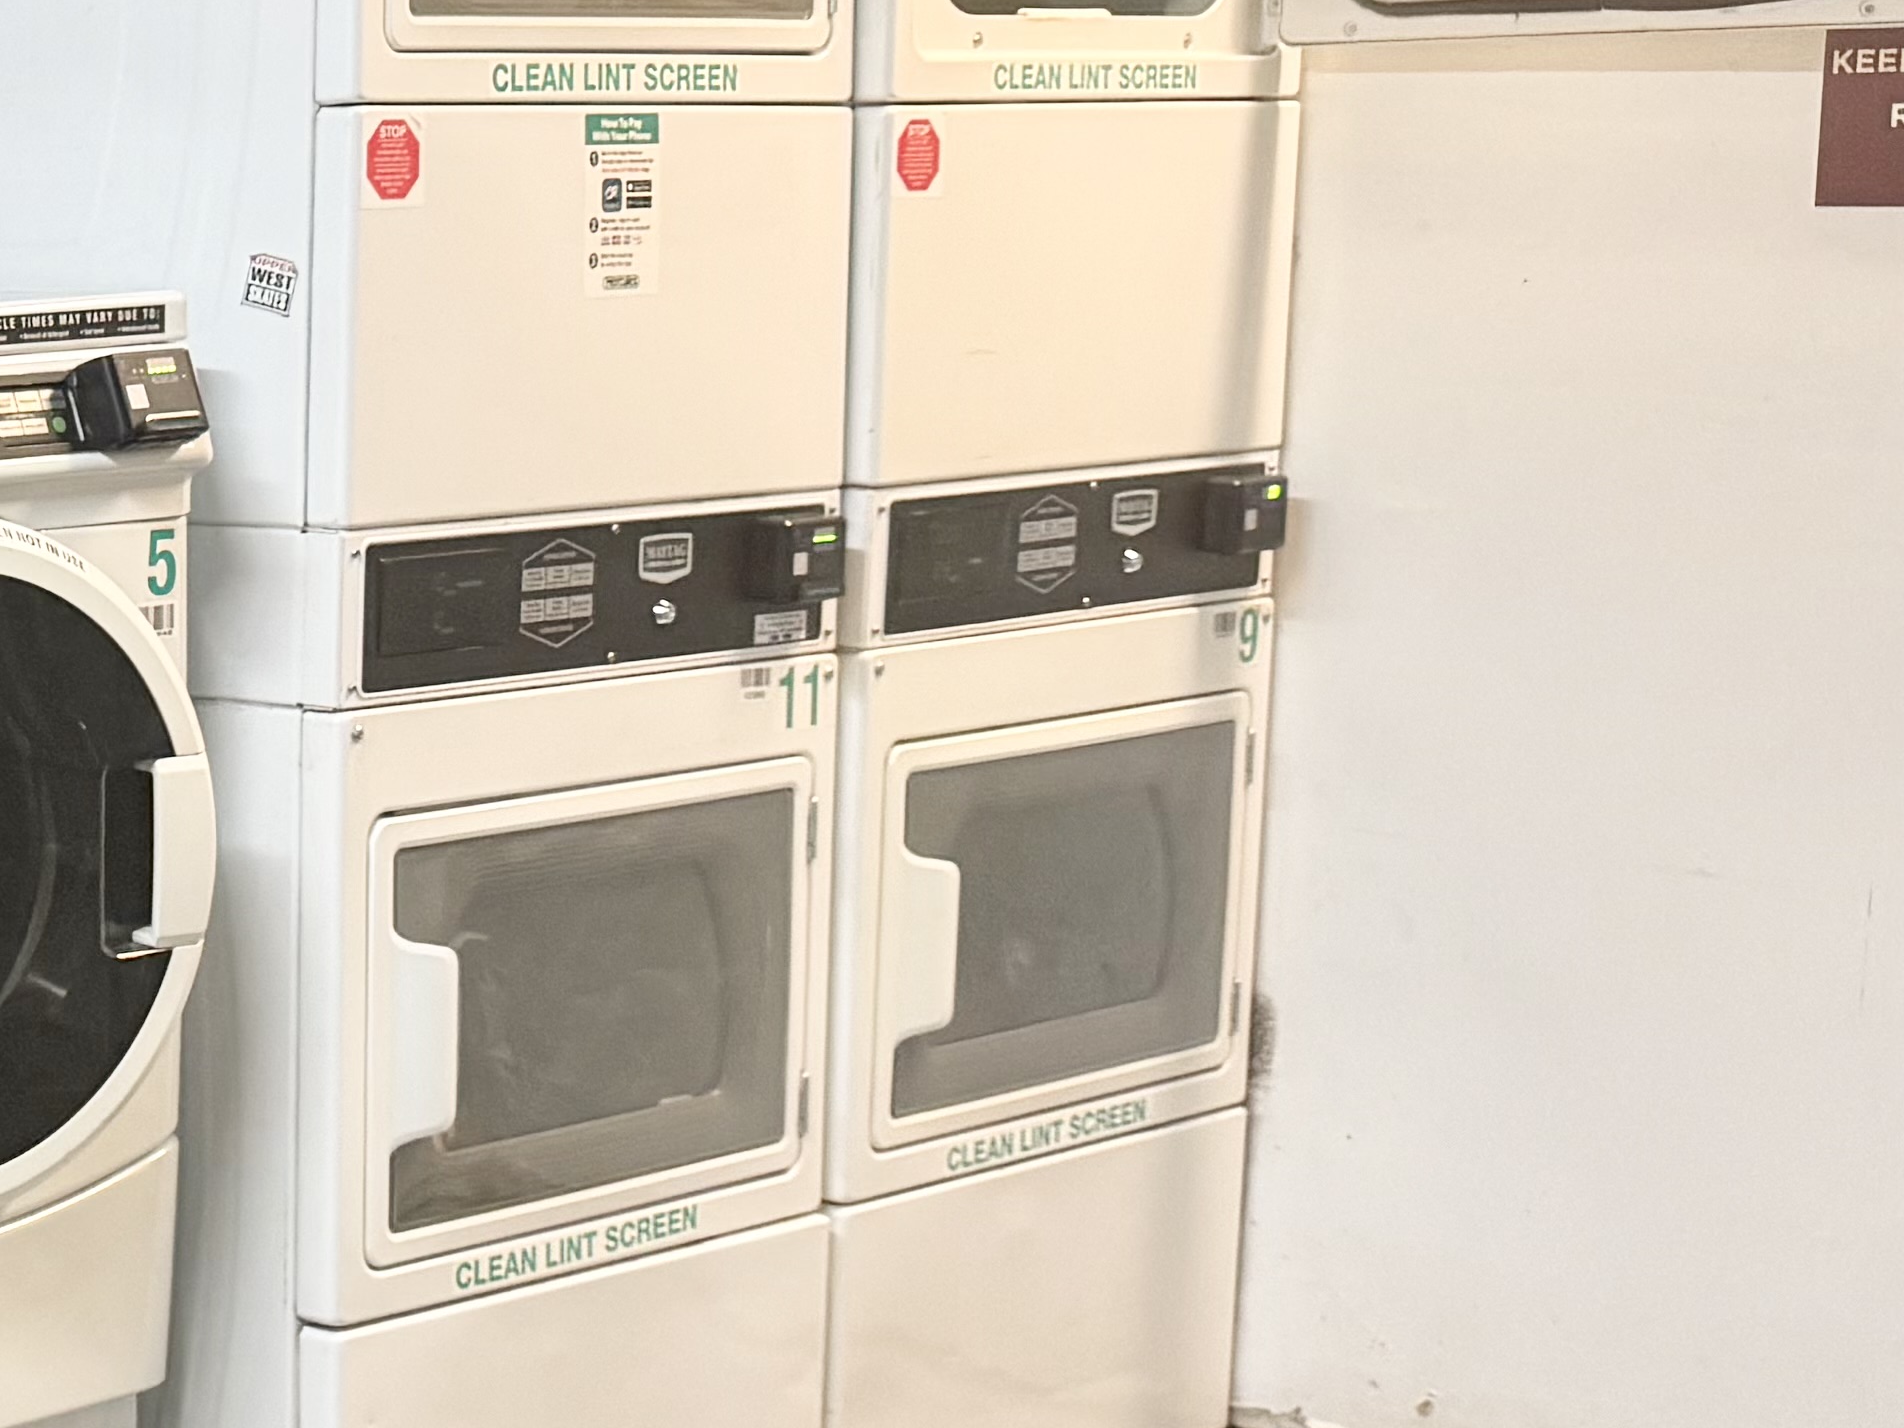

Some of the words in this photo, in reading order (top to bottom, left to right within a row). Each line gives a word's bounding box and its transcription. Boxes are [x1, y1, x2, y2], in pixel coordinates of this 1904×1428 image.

[1832, 47, 1904, 75] KEE
[492, 63, 575, 93] CLEAN
[583, 62, 636, 92] LINT
[643, 63, 739, 92] SCREEN
[993, 63, 1062, 90] CLEAN
[1068, 64, 1113, 90] LINT
[1118, 63, 1198, 90] SCREEN
[379, 124, 407, 139] STOP
[250, 266, 294, 291] WEST
[21, 314, 56, 329] TIMES
[58, 312, 81, 327] MAY
[86, 310, 113, 325] VARY
[117, 308, 138, 323] DUE
[16, 530, 42, 549] NOT
[147, 528, 177, 596] 5
[1238, 607, 1259, 664] 9
[778, 664, 819, 729] 11
[946, 1131, 1014, 1171] CLEAN
[1019, 1118, 1065, 1153] LINT
[1068, 1098, 1148, 1140] SCREEN
[455, 1245, 537, 1290] CLEAN
[545, 1230, 598, 1269] LINT
[604, 1204, 699, 1252] SCREEN
